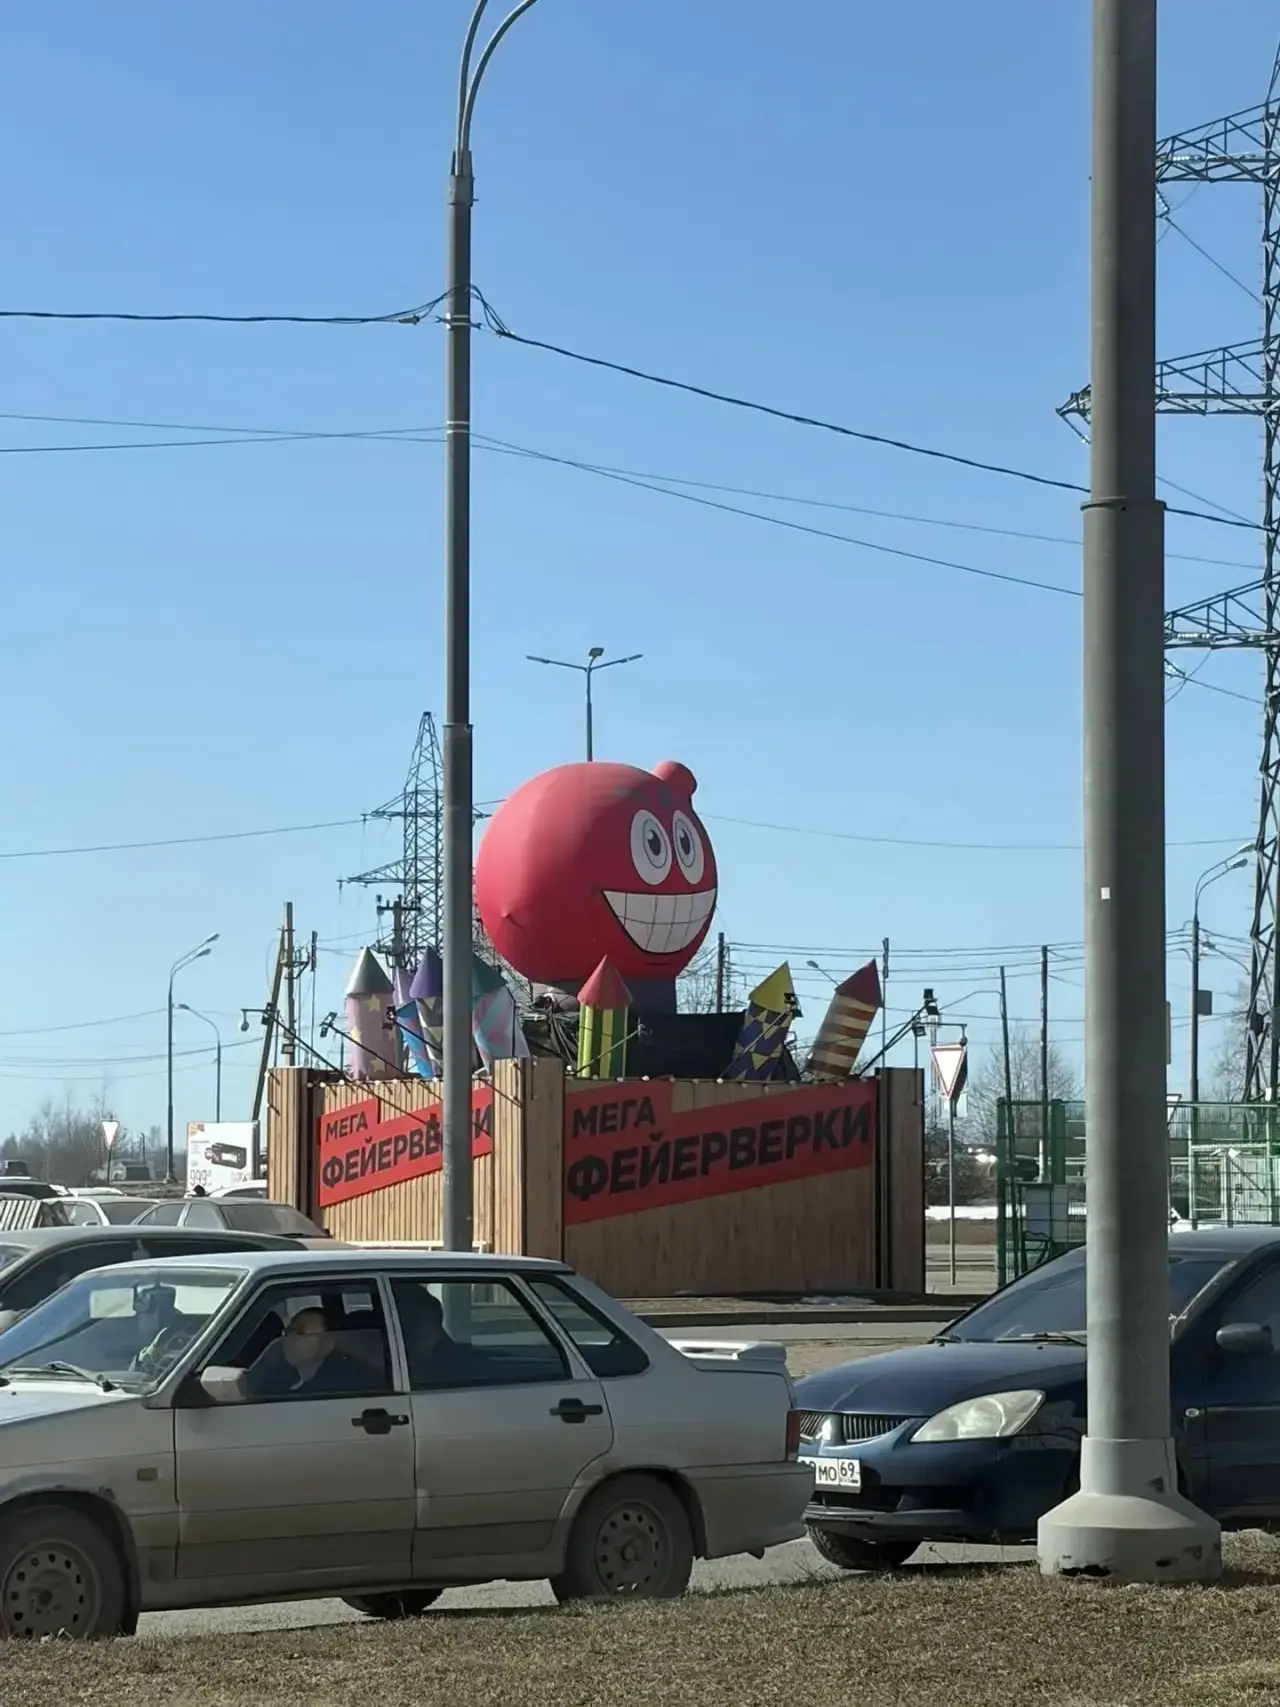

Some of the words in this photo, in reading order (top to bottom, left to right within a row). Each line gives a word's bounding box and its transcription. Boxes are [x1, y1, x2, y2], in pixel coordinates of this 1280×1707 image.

[325, 1111, 368, 1142] МЕГА
[572, 1097, 655, 1138] МЕГА
[322, 1104, 492, 1188] ФЕЙЕРВЕИ
[567, 1102, 871, 1201] ФЕЙЕРВЕРКИ
[840, 1461, 855, 1478] 69
